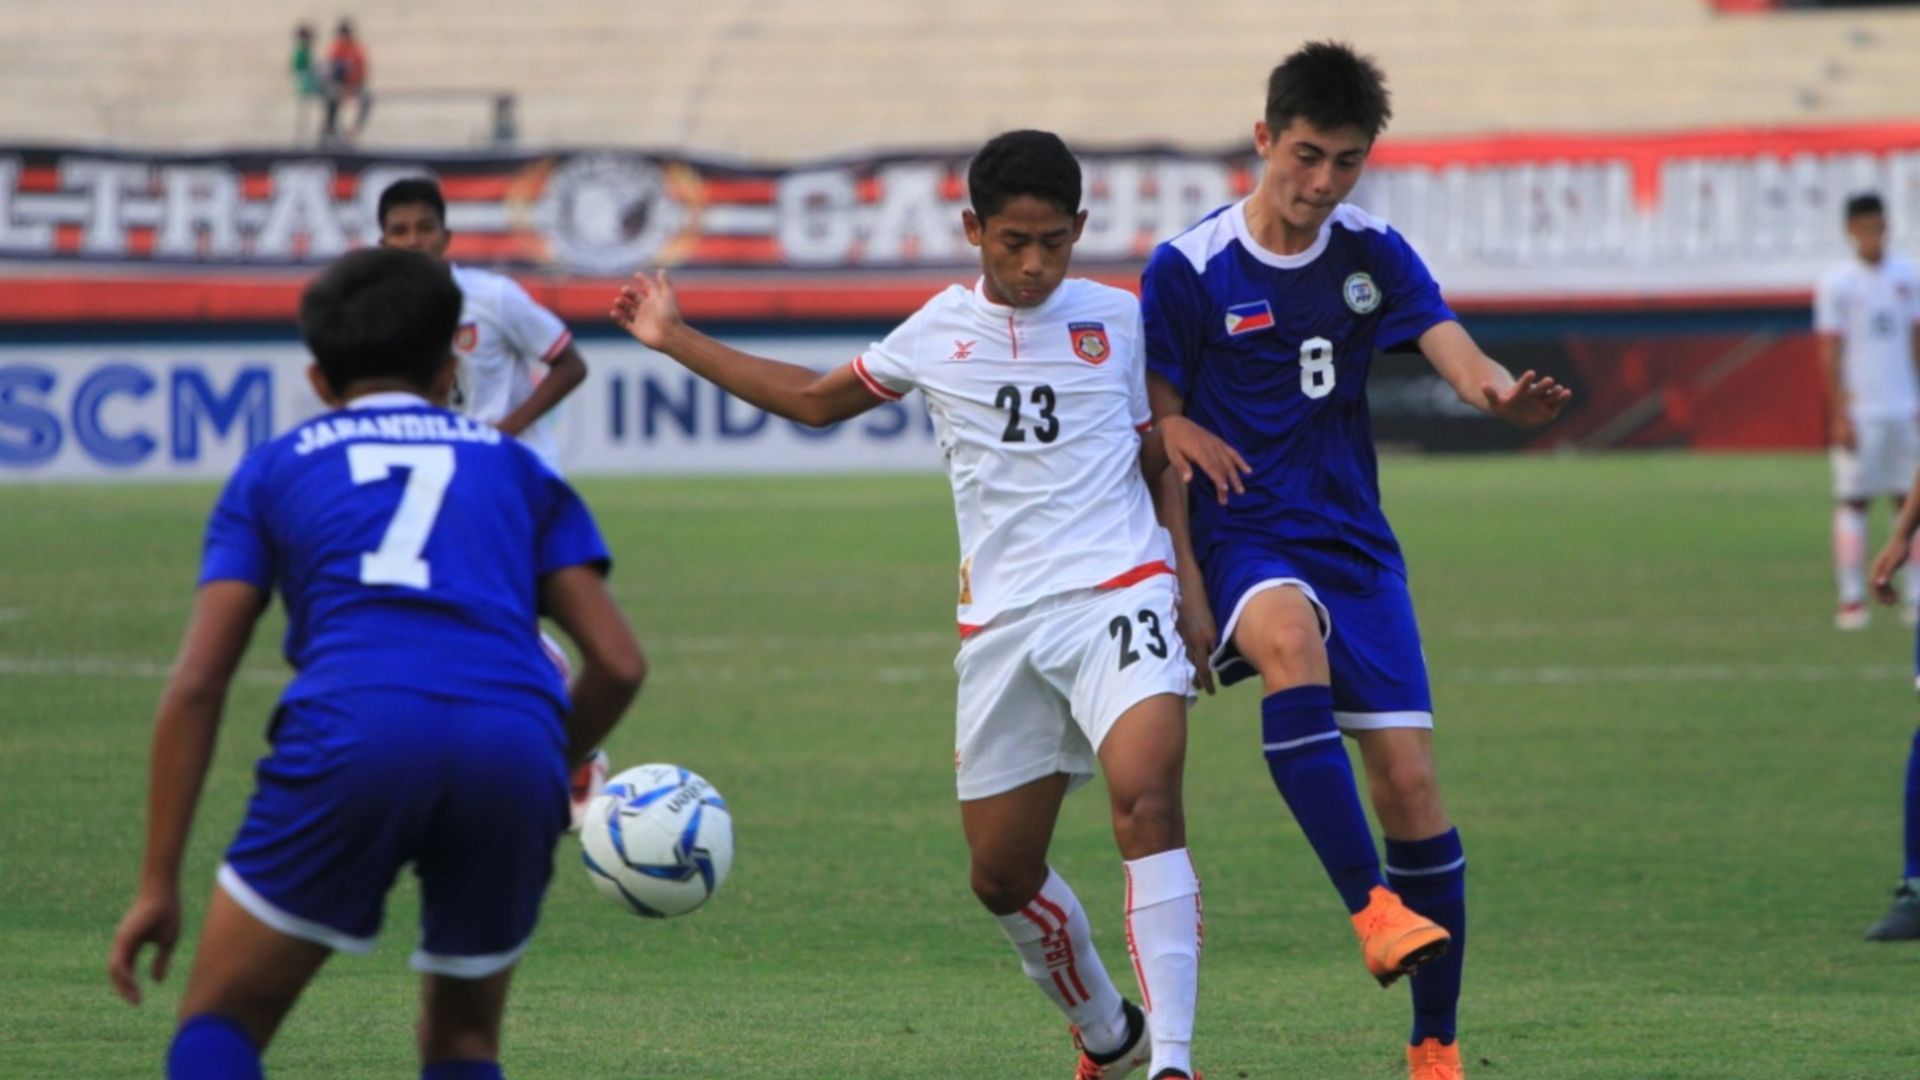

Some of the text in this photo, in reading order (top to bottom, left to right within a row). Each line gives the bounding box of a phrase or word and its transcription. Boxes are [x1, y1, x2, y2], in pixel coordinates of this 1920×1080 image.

[1300, 336, 1336, 399] 8
[0, 364, 271, 467] SCM
[610, 371, 934, 440] INDS
[995, 384, 1060, 443] 23
[347, 443, 457, 589] 7
[1109, 609, 1168, 672] 23
